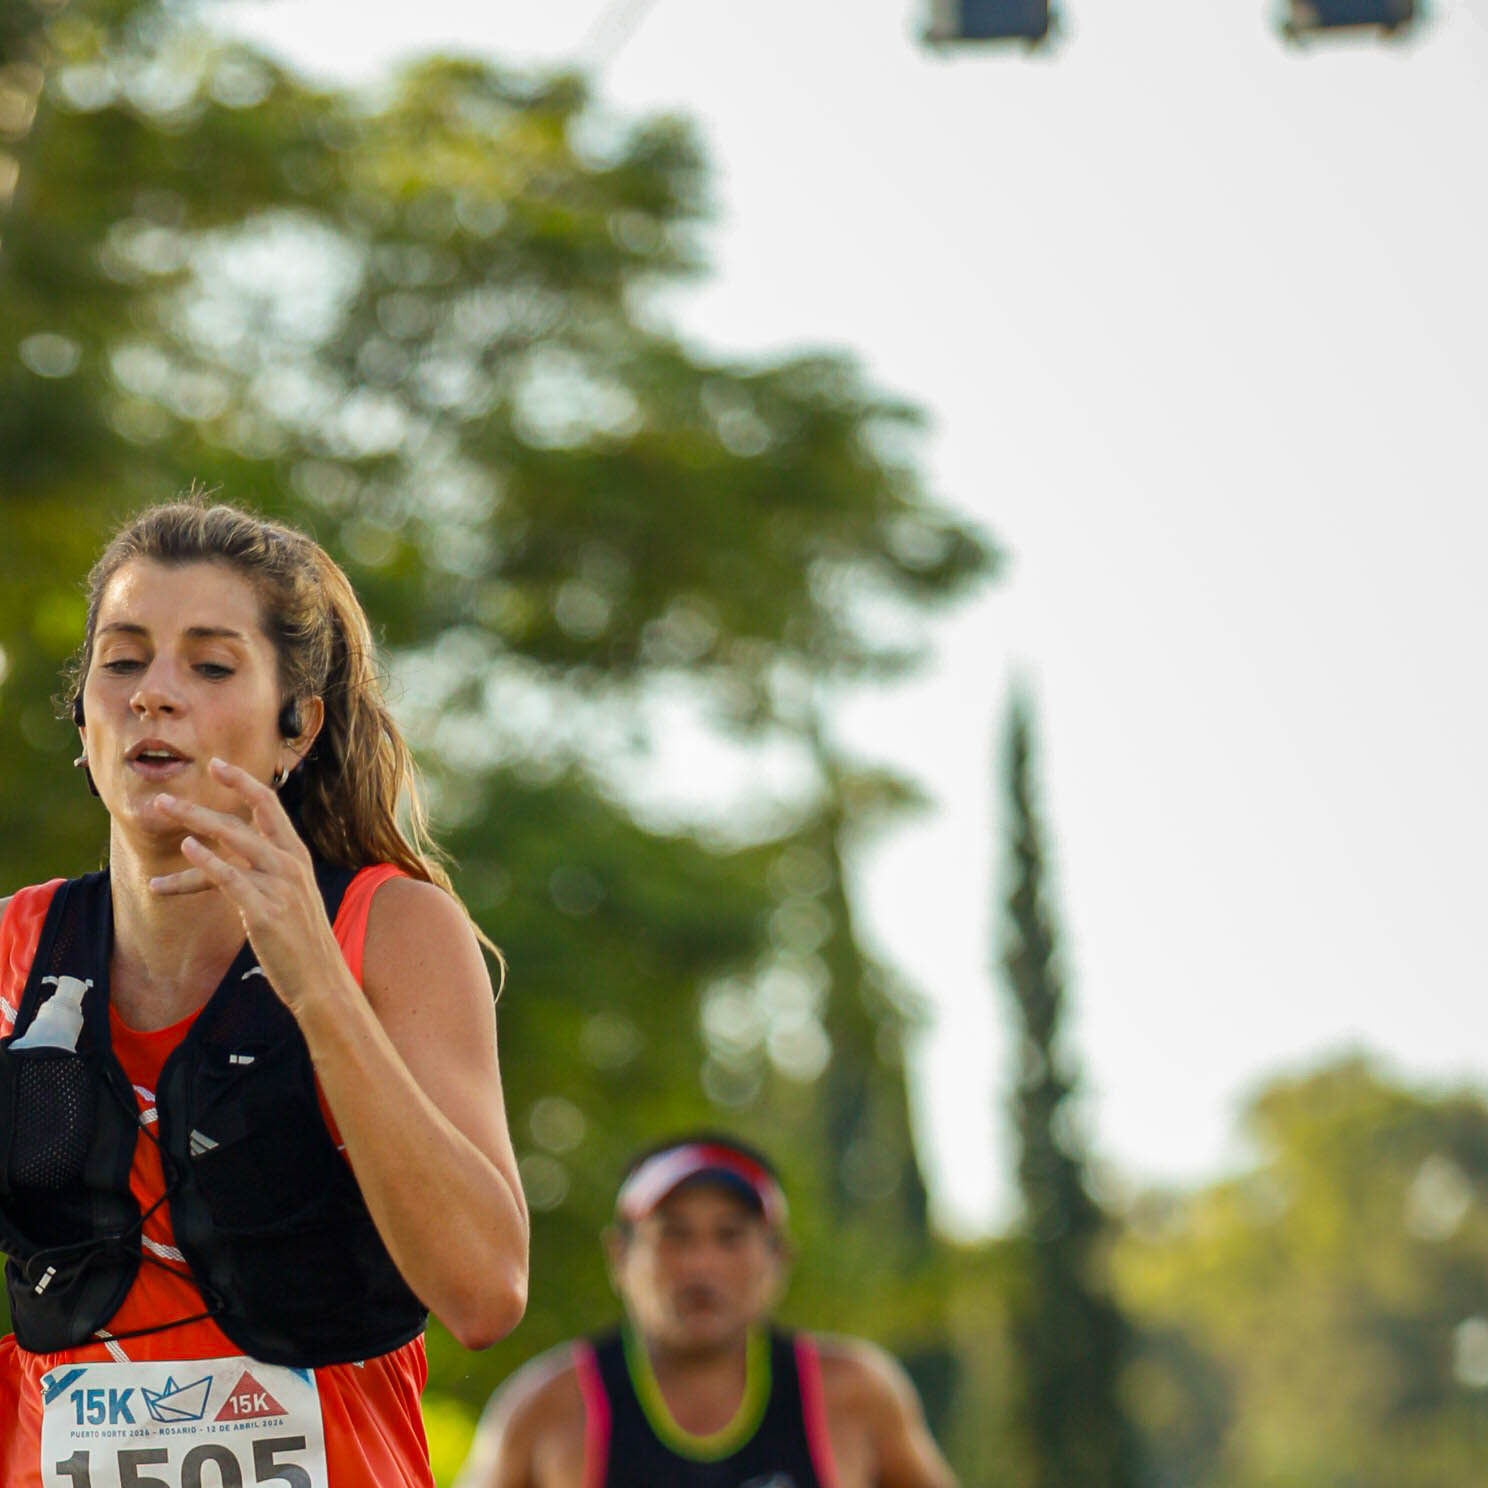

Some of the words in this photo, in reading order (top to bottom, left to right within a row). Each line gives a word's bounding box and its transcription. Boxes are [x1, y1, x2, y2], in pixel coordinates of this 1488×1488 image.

[70, 1388, 137, 1425] 15K
[229, 1392, 271, 1416] 15K
[70, 1430, 100, 1439] PUERTO
[101, 1429, 127, 1438] NORTE
[159, 1426, 197, 1435] ROSARIO
[206, 1425, 216, 1433] 12
[219, 1424, 231, 1432] DE
[233, 1422, 259, 1431] ABRIL
